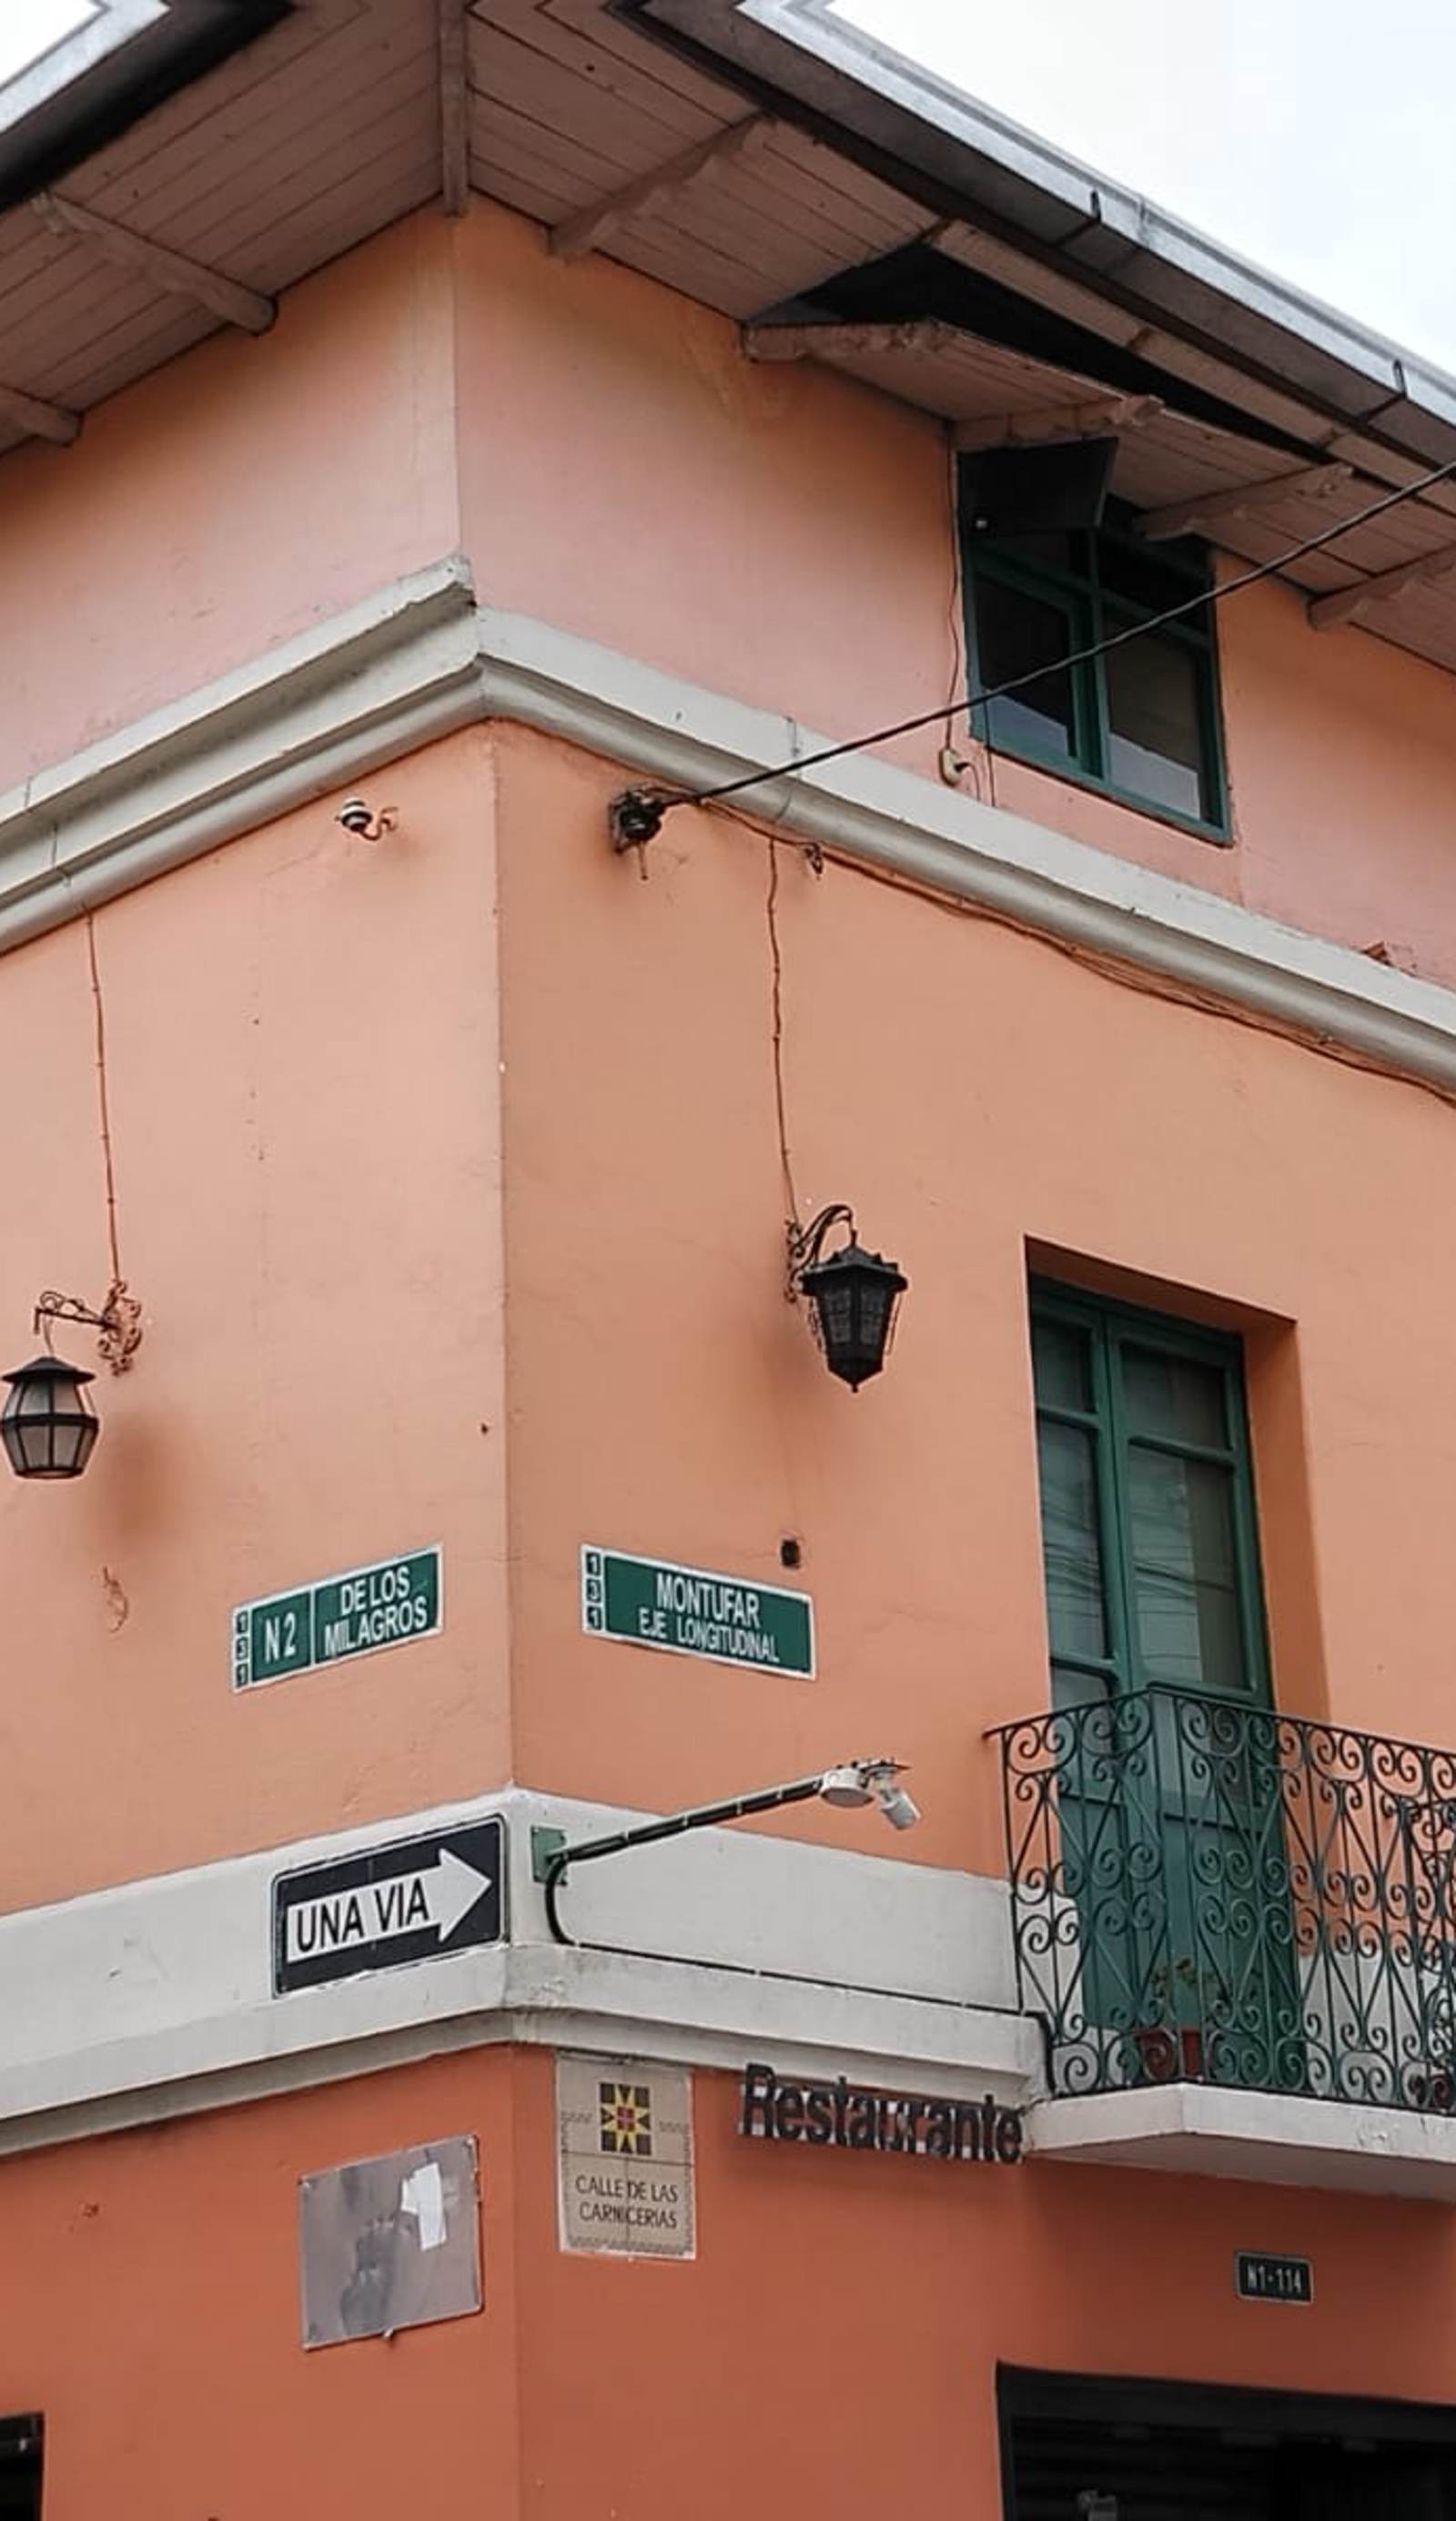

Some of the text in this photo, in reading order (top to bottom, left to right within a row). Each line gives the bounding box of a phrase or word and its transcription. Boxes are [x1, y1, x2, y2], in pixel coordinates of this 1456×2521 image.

[340, 1565, 410, 1616] DE LOS
[655, 1572, 761, 1629] MONTUFAR
[324, 1595, 429, 1656] MILAGROS
[638, 1607, 781, 1663] EJE LONGITUDINAL
[297, 1877, 430, 1952] UNA VIA
[742, 2061, 1024, 2163] Restaurante
[575, 2173, 679, 2203] CALLE DE LAS
[579, 2200, 678, 2230] CARNICERIAS
